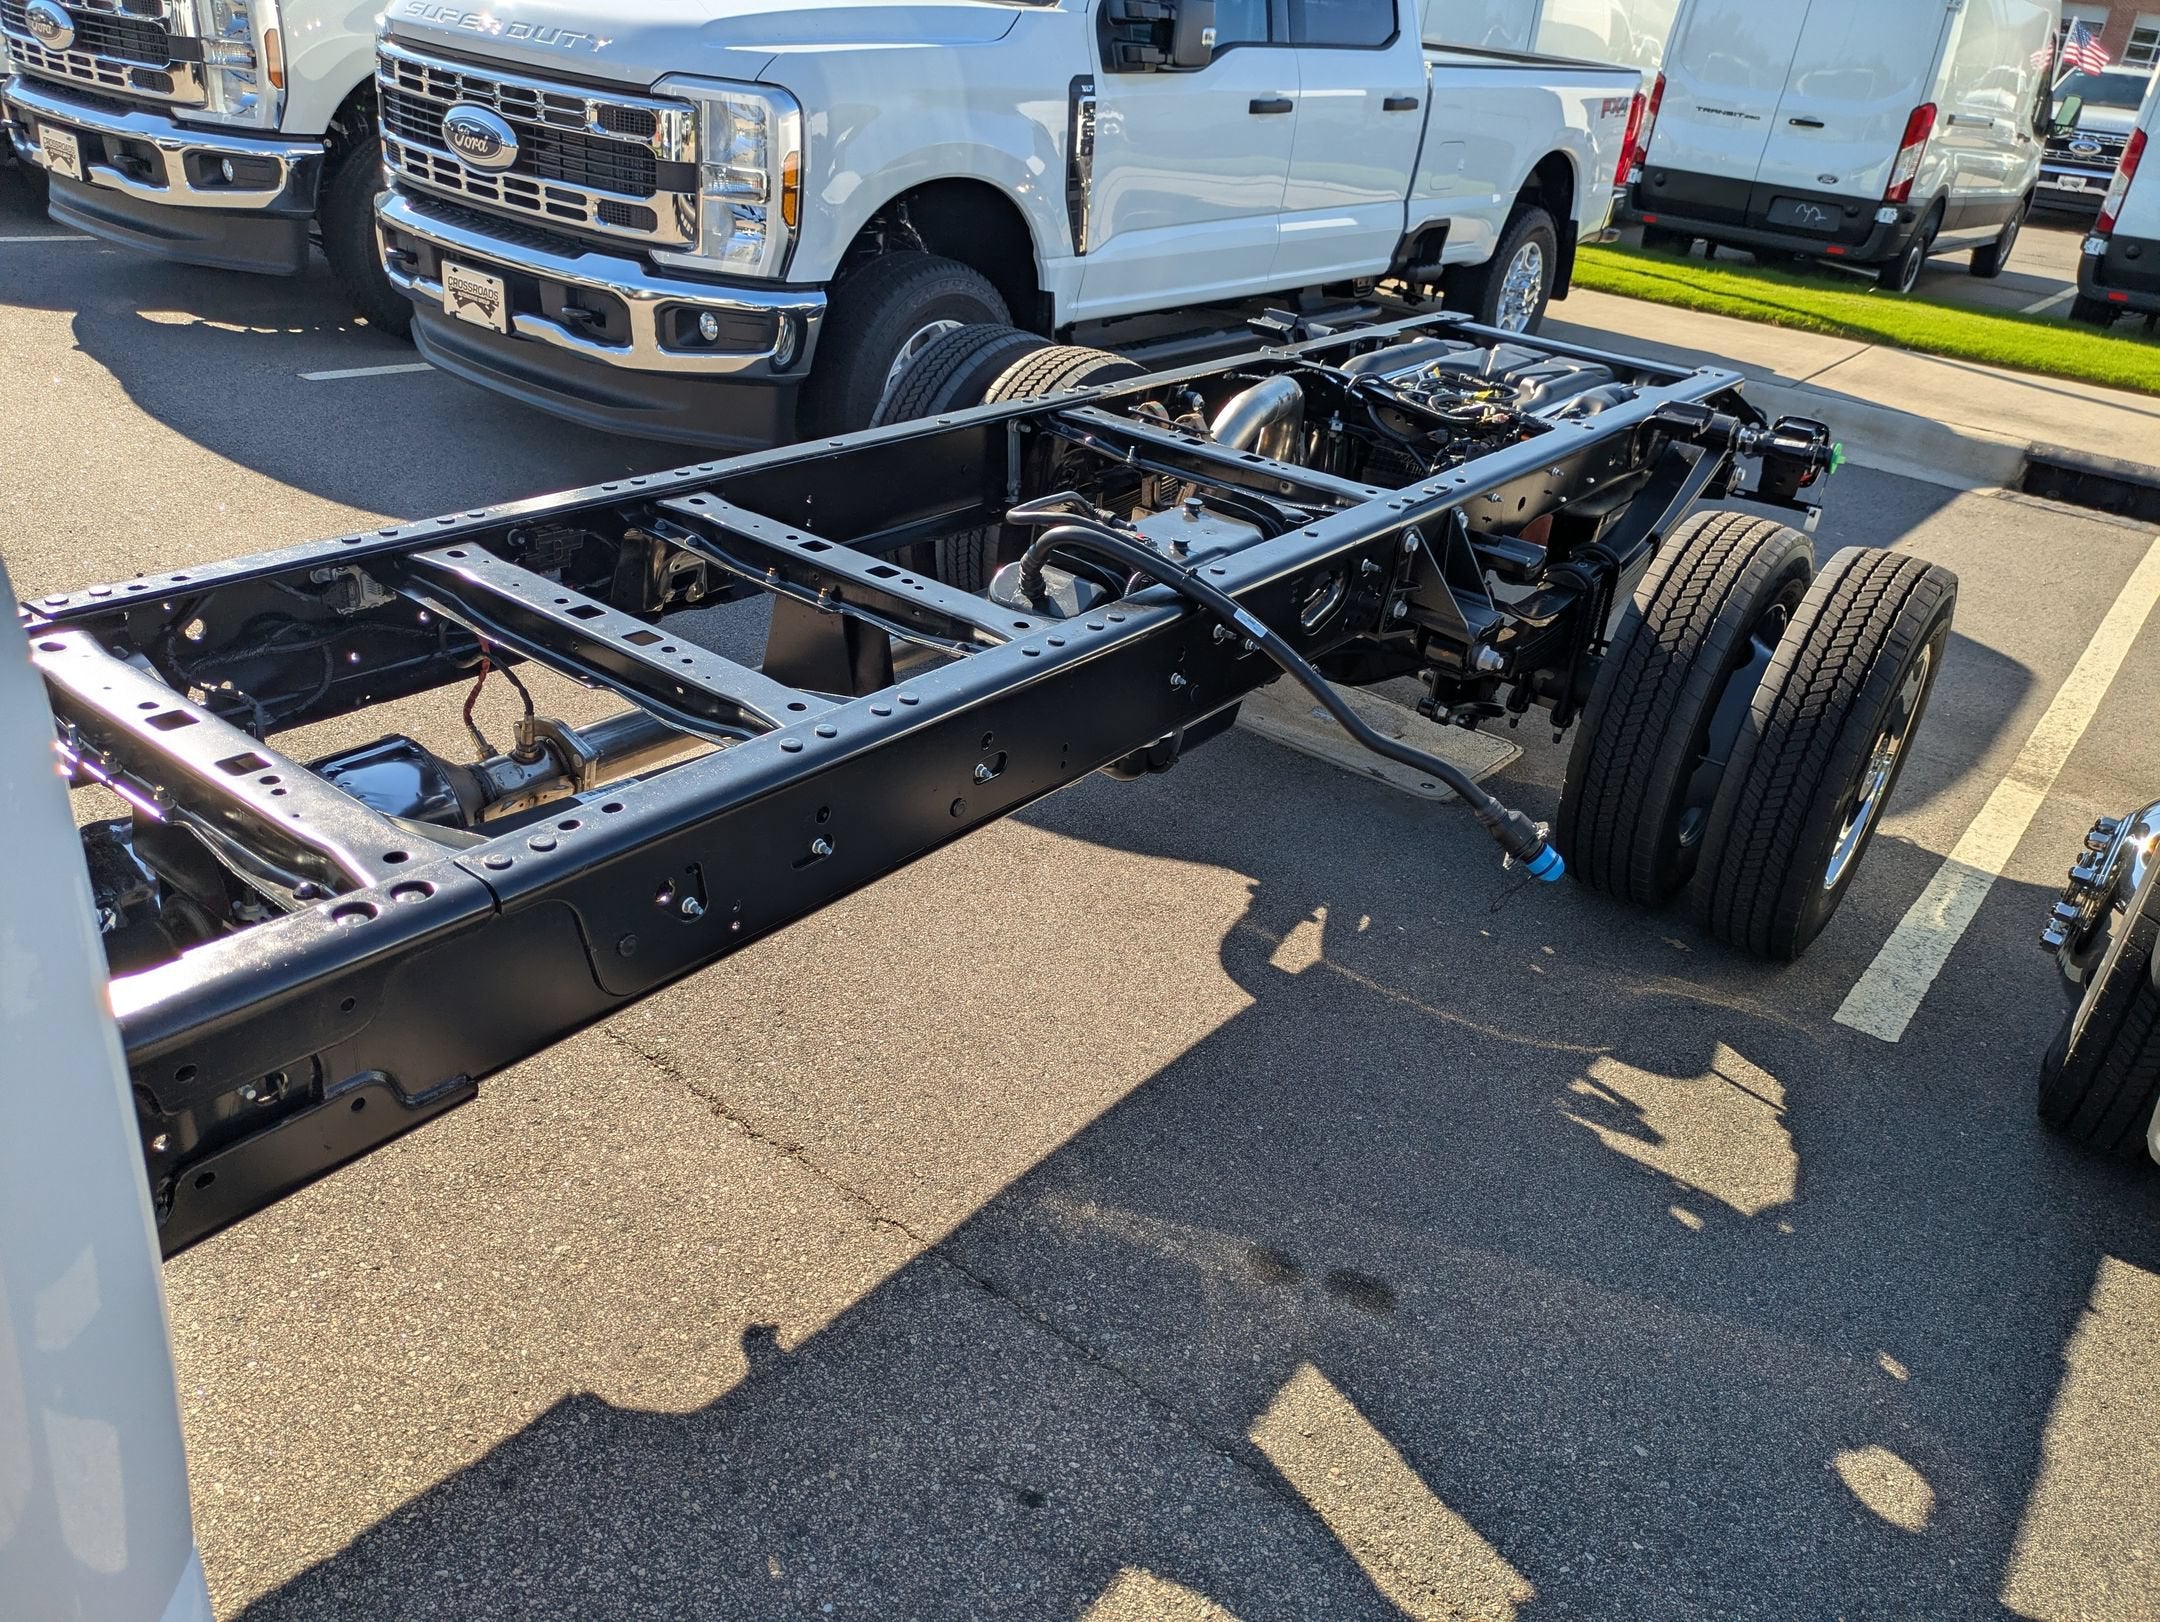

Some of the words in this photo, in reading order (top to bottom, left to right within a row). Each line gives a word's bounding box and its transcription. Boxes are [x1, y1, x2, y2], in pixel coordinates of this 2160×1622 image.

[404, 0, 503, 36] SUPER
[506, 20, 614, 53] DUTY
[1695, 106, 1744, 118] TRANSIT
[454, 122, 490, 153] Ford
[448, 276, 499, 301] CROSSROADS
